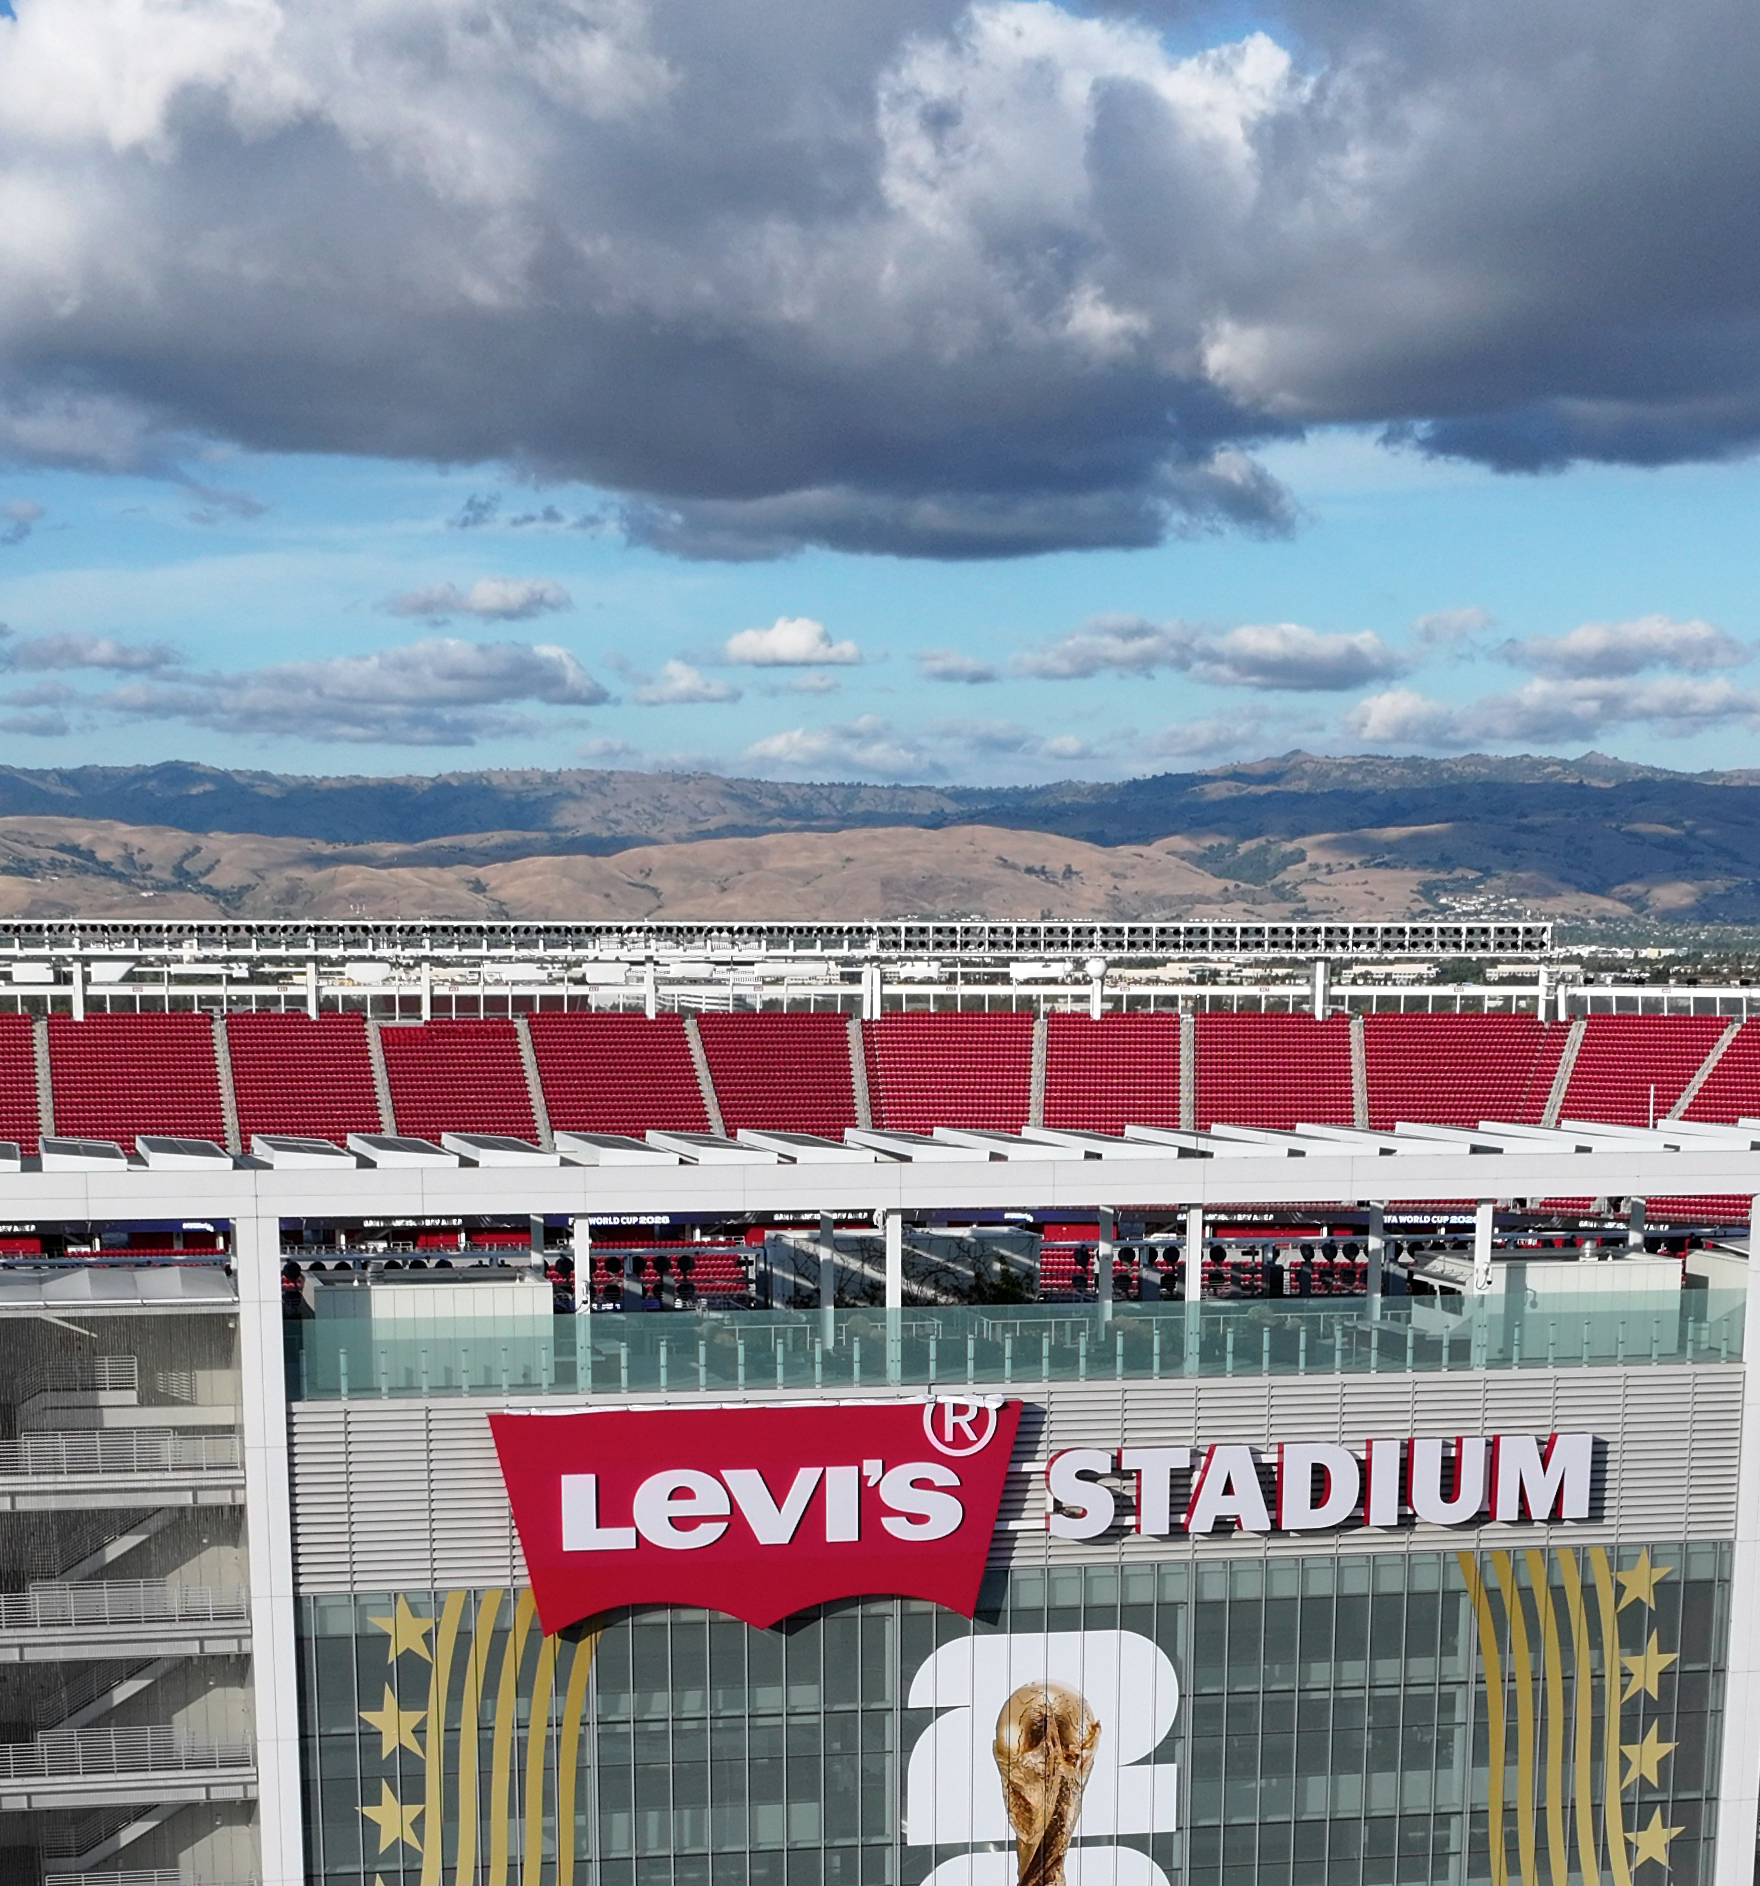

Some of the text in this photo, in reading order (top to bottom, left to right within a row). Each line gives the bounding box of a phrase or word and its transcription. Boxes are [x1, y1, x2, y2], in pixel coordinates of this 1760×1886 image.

[1383, 1216, 1398, 1224] IFA
[559, 1431, 1597, 1552] Levi's STADIUM
